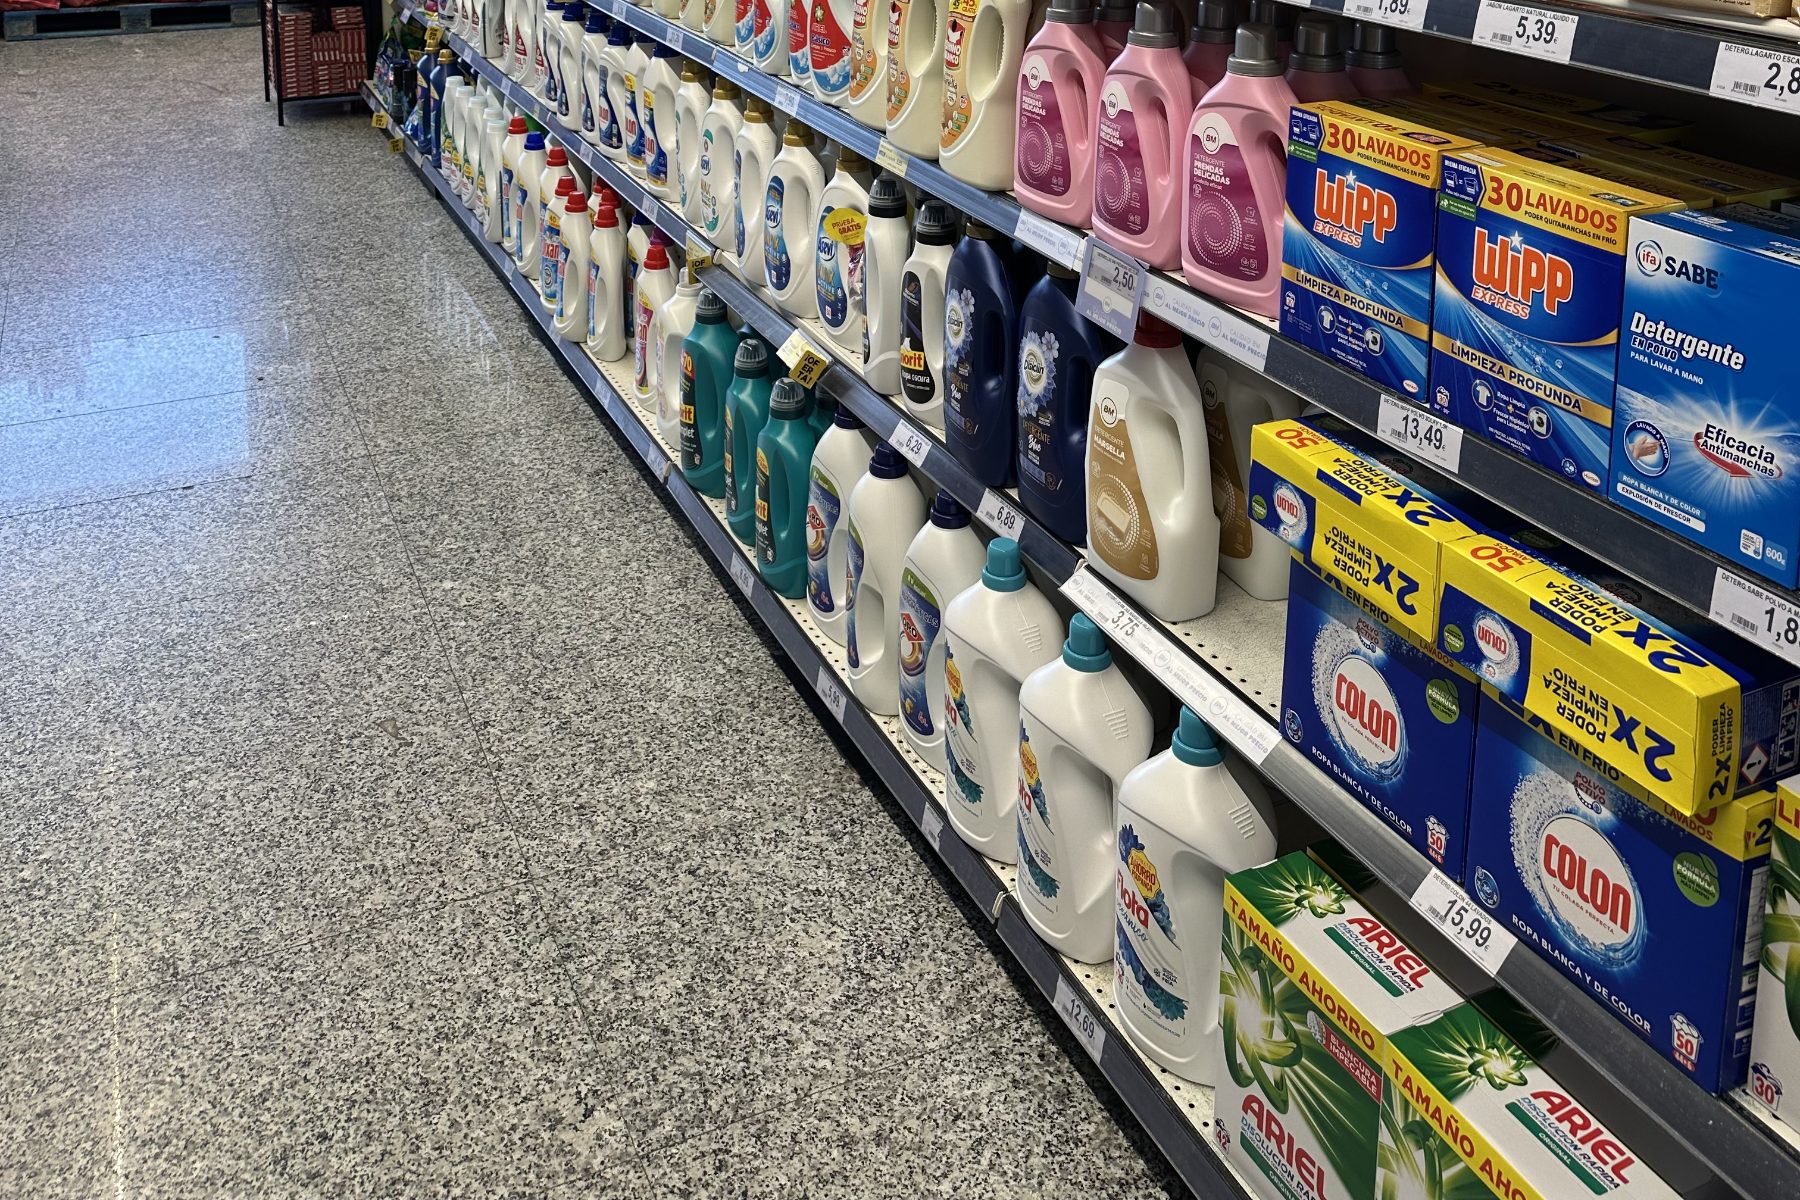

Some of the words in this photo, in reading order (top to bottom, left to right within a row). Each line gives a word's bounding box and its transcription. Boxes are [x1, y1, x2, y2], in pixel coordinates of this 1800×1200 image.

[1503, 4, 1525, 14] LAGARTO
[1526, 9, 1548, 18] NATURAL
[1205, 134, 1217, 144] BM
[1327, 122, 1356, 153] 30
[1357, 133, 1431, 170] LAVADOS
[1193, 168, 1230, 185] DELICADAS
[1194, 161, 1225, 176] PRENDAS
[1357, 152, 1372, 162] PODER
[1373, 157, 1410, 176] QUITAMANCHAS
[1418, 171, 1430, 180] FRÍO
[1487, 176, 1524, 212] 30
[1525, 188, 1617, 233] LAVADOS
[832, 218, 855, 229] PRUEBA
[838, 222, 862, 236] GRATIS
[1314, 220, 1362, 248] EXPRESS
[1525, 210, 1544, 222] PODER
[1544, 217, 1592, 238] QUITAMANCHAS
[1602, 234, 1617, 246] FRÍO
[1642, 250, 1656, 266] ifa
[1664, 256, 1718, 290] SABE
[1296, 272, 1341, 300] LIMPIEZA
[1344, 293, 1403, 328] PROFUNDA
[1472, 286, 1530, 319] EXPRESS
[1630, 312, 1744, 370] Detergente
[1632, 336, 1645, 350] EN
[1647, 340, 1678, 361] POLVO
[900, 353, 923, 368] norit
[1630, 352, 1649, 364] PARA
[1651, 358, 1673, 373] LAVAR
[1682, 371, 1703, 385] MANO
[1451, 343, 1505, 378] LIMPIEZA
[1509, 372, 1582, 412] PROFUNDA
[1103, 405, 1115, 415] BM
[905, 435, 922, 455] 6,29
[1093, 434, 1125, 461] MARSELLA
[1275, 428, 1320, 450] 50
[1704, 423, 1775, 465] Eficacia
[1333, 457, 1390, 492] LIMPIEZA
[1701, 440, 1775, 477] Antimanchas
[1333, 469, 1377, 496] PODER
[996, 505, 1015, 530] 6,89
[1276, 495, 1298, 518] COLON
[1383, 489, 1455, 527] 2X
[1622, 487, 1652, 505] EXPLOSIÓN
[1654, 501, 1662, 510] DE
[1663, 505, 1691, 523] FRESCOR
[1324, 533, 1371, 573] LIMPIEZA
[1352, 542, 1372, 558] EN
[1470, 545, 1525, 573] 50
[1333, 557, 1370, 588] PODER
[1373, 553, 1420, 616] 2X
[1546, 581, 1621, 627] LIMPIEZA
[1549, 598, 1608, 634] PODER
[1112, 611, 1139, 637] 3,75
[1357, 618, 1379, 636] POLVO
[1477, 623, 1507, 656] COLON
[1419, 639, 1454, 669] LAVADOS
[1615, 622, 1710, 675] 2X
[1335, 672, 1397, 753] COLON
[1542, 675, 1609, 727] LIMPIEZA
[1556, 701, 1607, 744] PODER
[1610, 705, 1676, 783] 2X
[1312, 745, 1332, 768] ROPA
[1333, 763, 1362, 794] BLANCA
[1363, 788, 1370, 800] Y
[1371, 795, 1382, 810] DE
[1383, 805, 1413, 836] COLOR
[1572, 780, 1606, 805] ACTIVO
[1576, 771, 1606, 797] POLVO
[1709, 754, 1731, 800] 2X
[1663, 803, 1713, 842] LAVADOS
[1428, 831, 1443, 851] 50
[1131, 856, 1156, 886] AHORRO
[1543, 833, 1631, 934] COLON
[1117, 869, 1149, 930] Flota
[1345, 917, 1432, 989] ARIEL
[1349, 950, 1376, 975] ORIGINAL
[1229, 895, 1296, 974] TAMAÑO
[1298, 970, 1376, 1051] AHORRO
[1511, 913, 1539, 943] ROPA
[1540, 938, 1582, 977] BLANCA
[1584, 972, 1593, 985] Y
[1593, 980, 1609, 1000] DE
[1611, 994, 1651, 1033] COLOR
[1330, 1033, 1378, 1085] BLANCURA
[1676, 1031, 1695, 1057] 50
[1329, 1042, 1378, 1097] IMPECABLE
[1754, 1075, 1776, 1105] 30
[1392, 1058, 1475, 1158] TAMAÑO
[1216, 1130, 1227, 1150] 42
[1530, 1090, 1636, 1185] ARIEL
[1538, 1132, 1572, 1165] ORIGINAL
